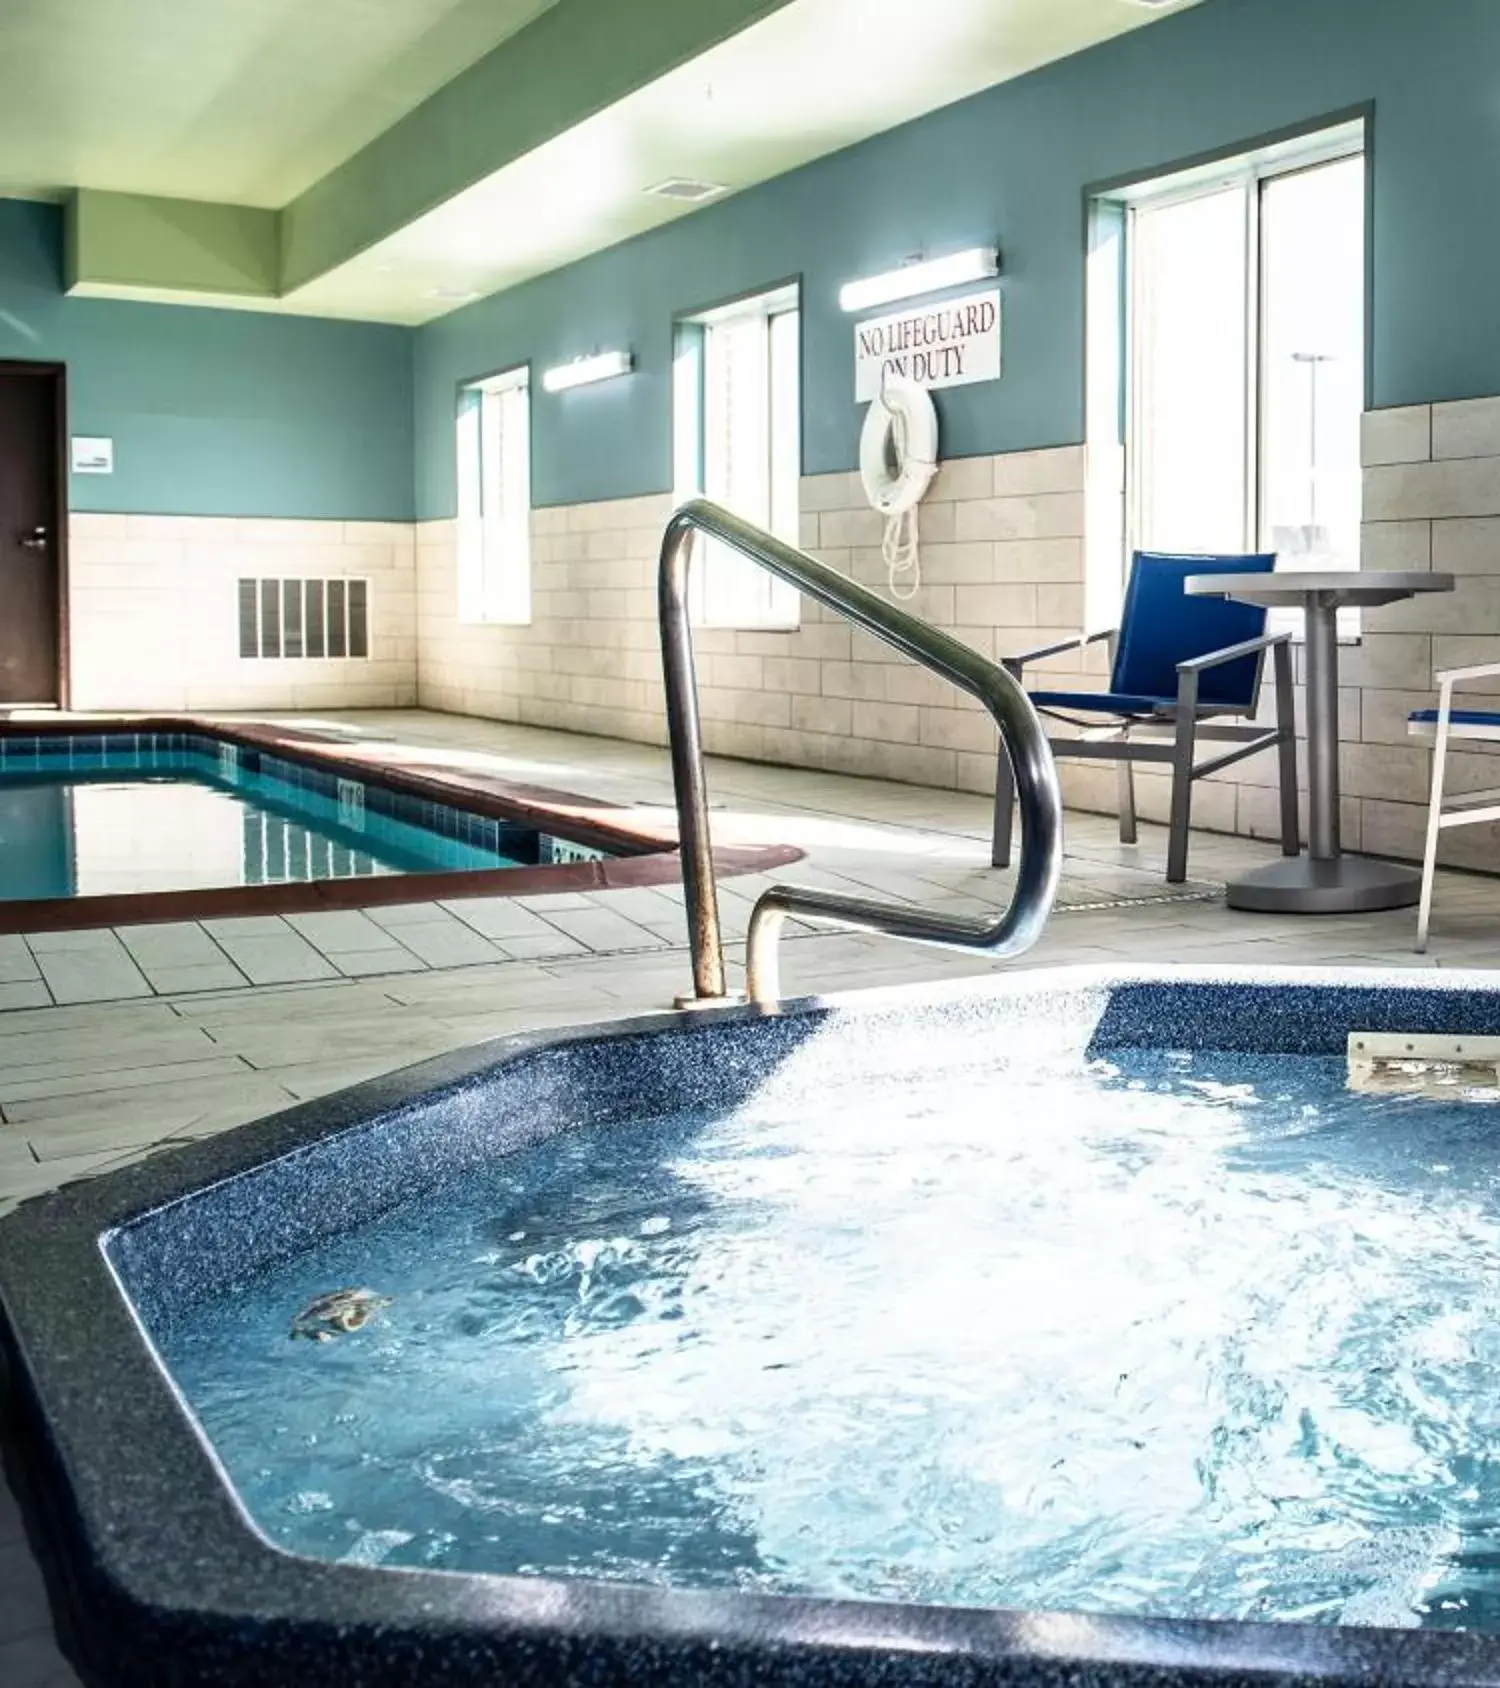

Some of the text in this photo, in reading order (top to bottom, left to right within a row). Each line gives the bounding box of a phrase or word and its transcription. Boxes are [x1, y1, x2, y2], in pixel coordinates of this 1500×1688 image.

[859, 301, 995, 360] NO LIFEGUARD
[913, 344, 966, 383] DUTY
